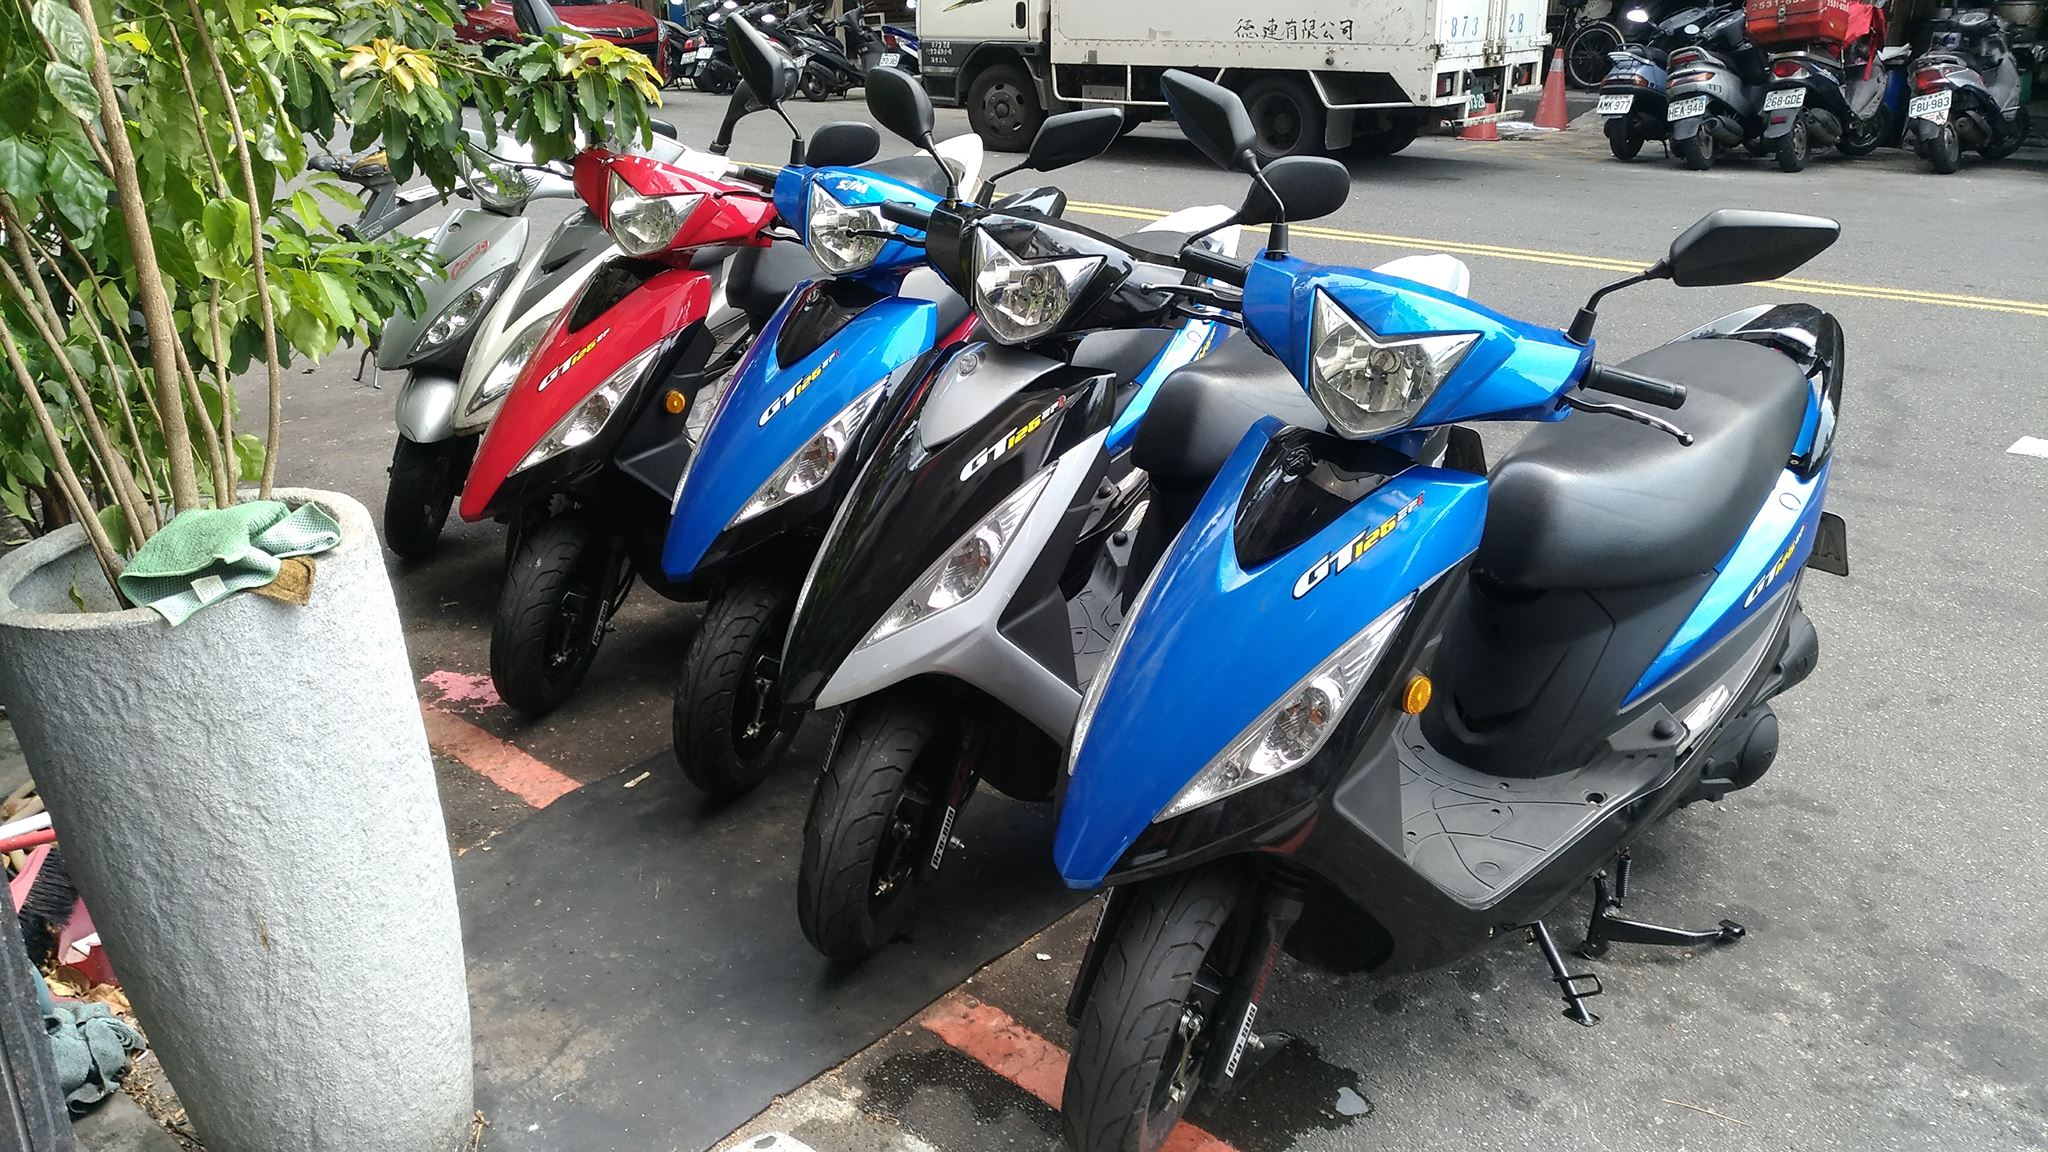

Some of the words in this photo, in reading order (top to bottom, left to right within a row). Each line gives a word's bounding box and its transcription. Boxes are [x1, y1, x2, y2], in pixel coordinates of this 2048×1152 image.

[1451, 16, 1478, 38] 873
[1597, 100, 1630, 111] AMK-977
[1765, 92, 1803, 108] 268-GDE
[1910, 96, 1951, 115] F8U-983
[1668, 101, 1705, 120] HEA-948
